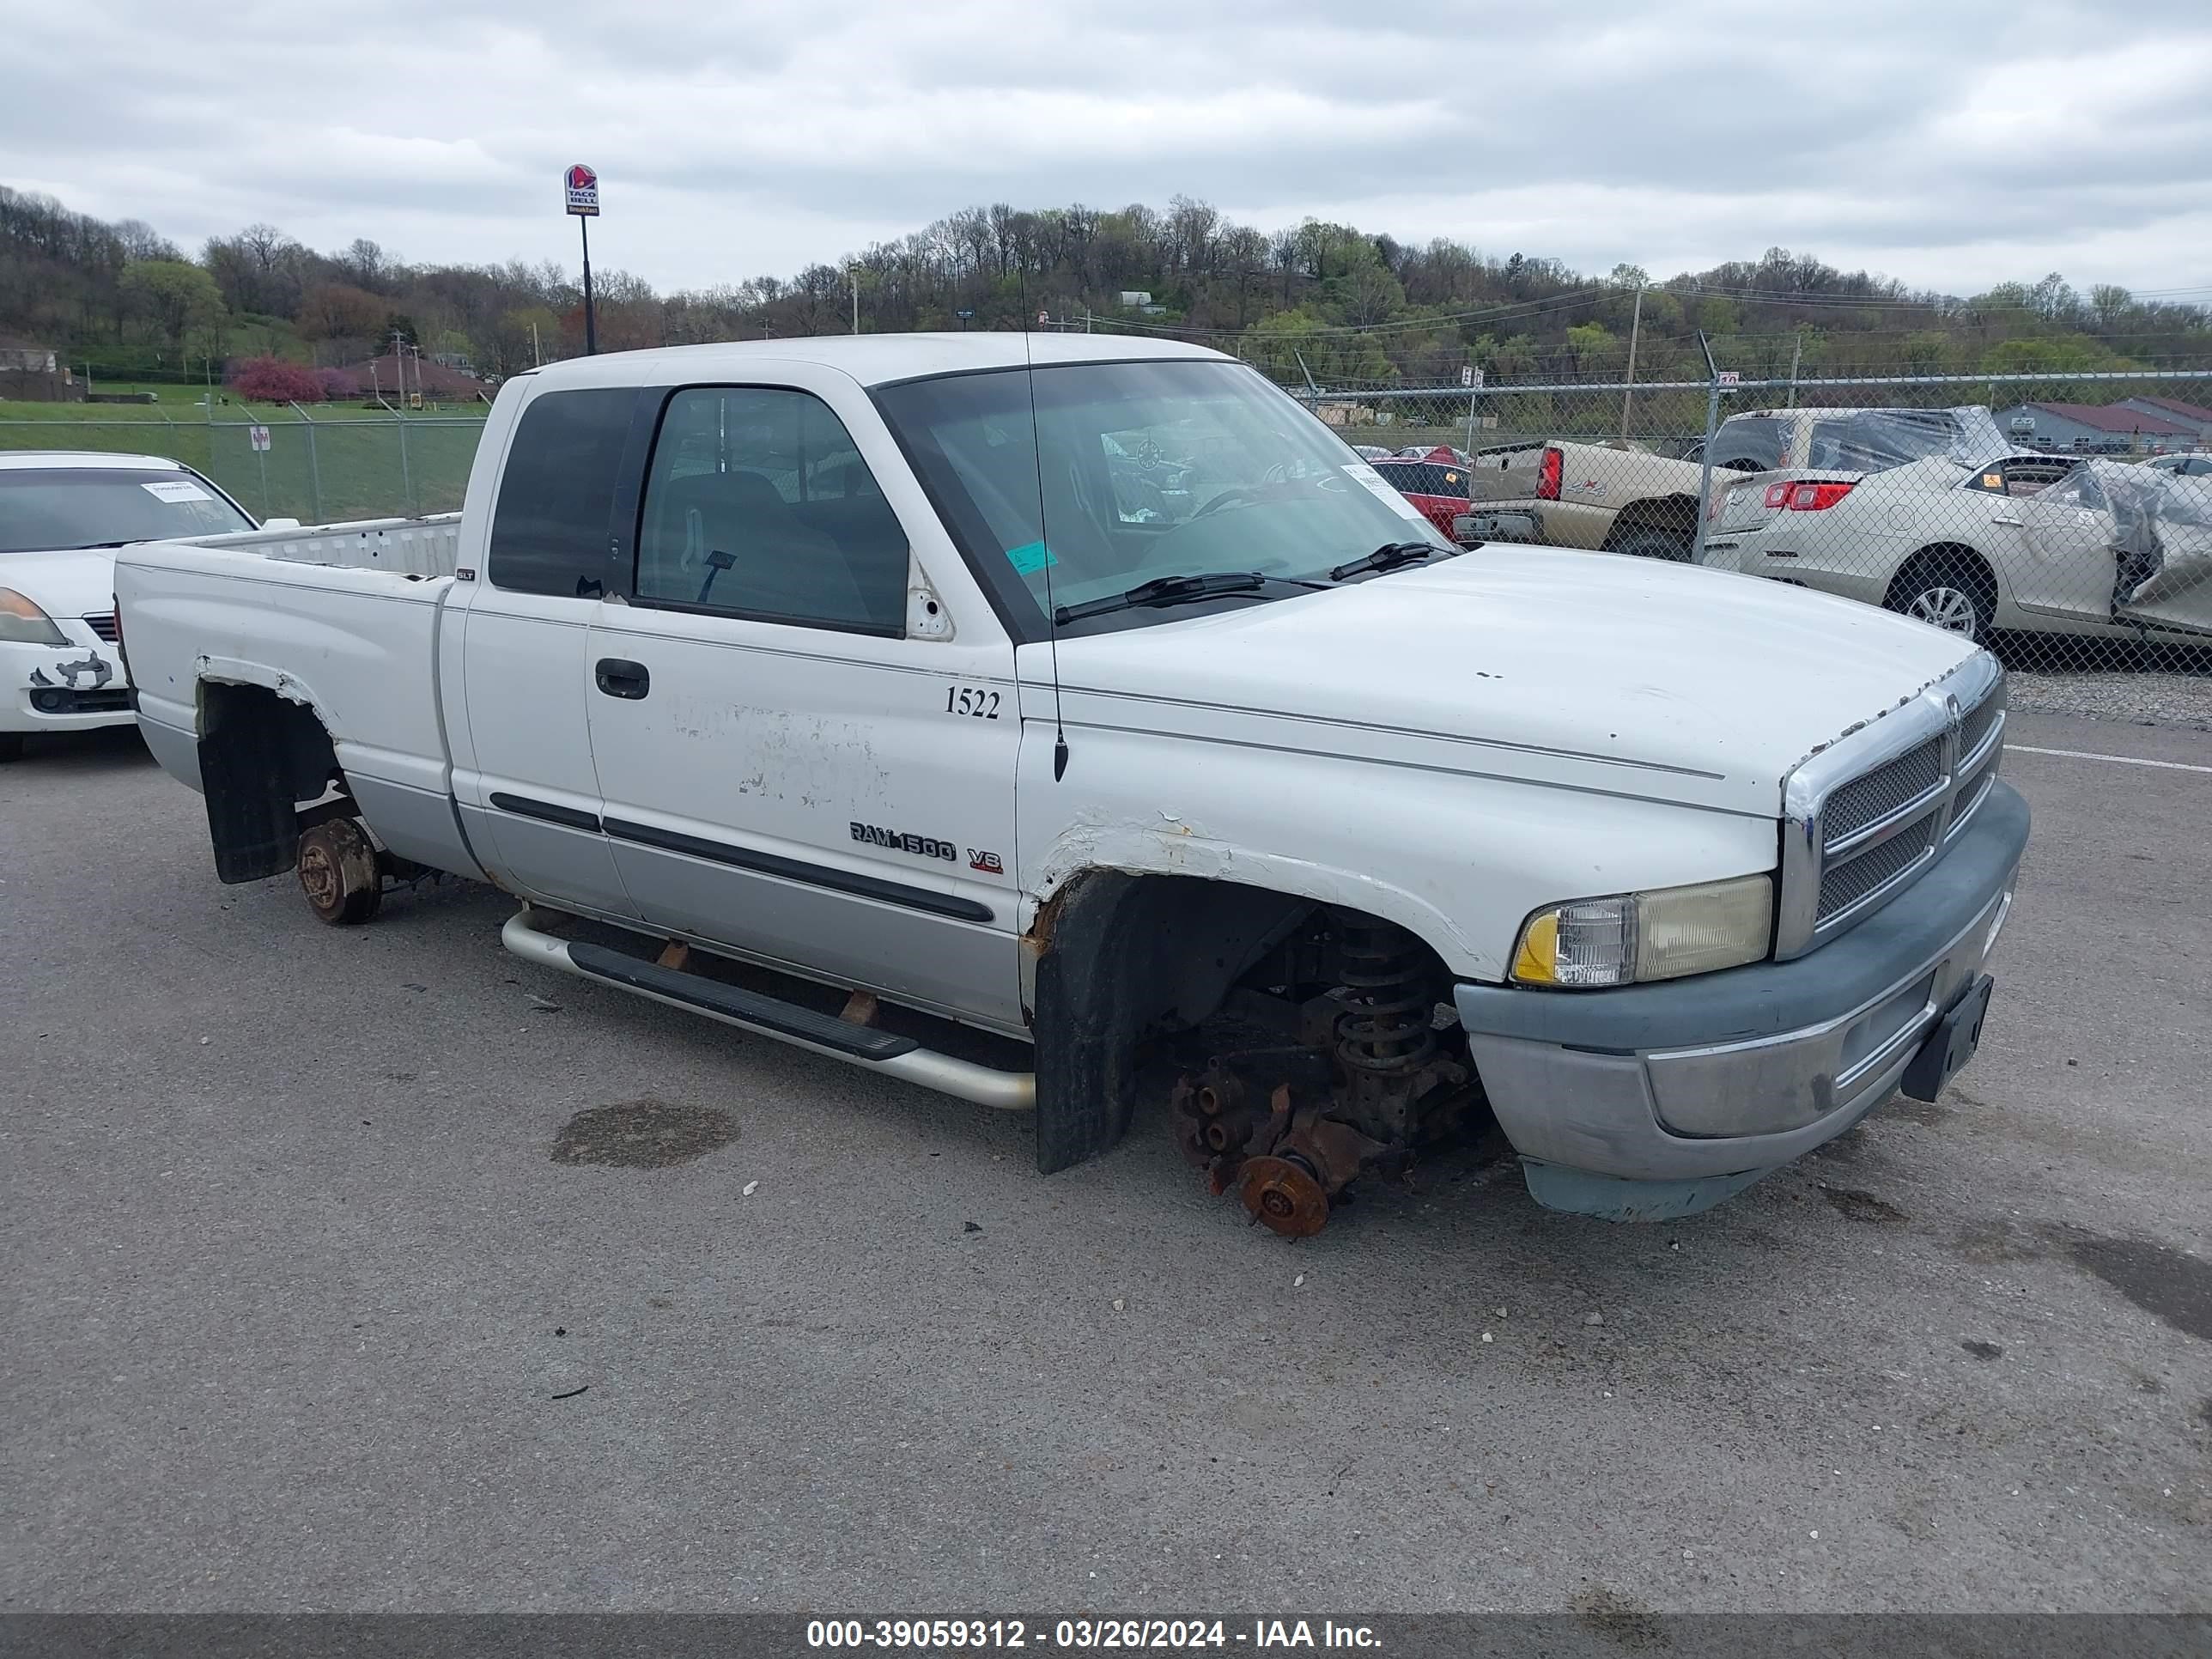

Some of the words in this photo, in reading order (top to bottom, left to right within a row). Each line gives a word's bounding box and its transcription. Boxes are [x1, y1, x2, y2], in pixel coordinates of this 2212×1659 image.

[945, 685, 1000, 720] 1522
[849, 822, 895, 848] RAM
[897, 831, 957, 862] 1500
[967, 848, 1002, 868] V8
